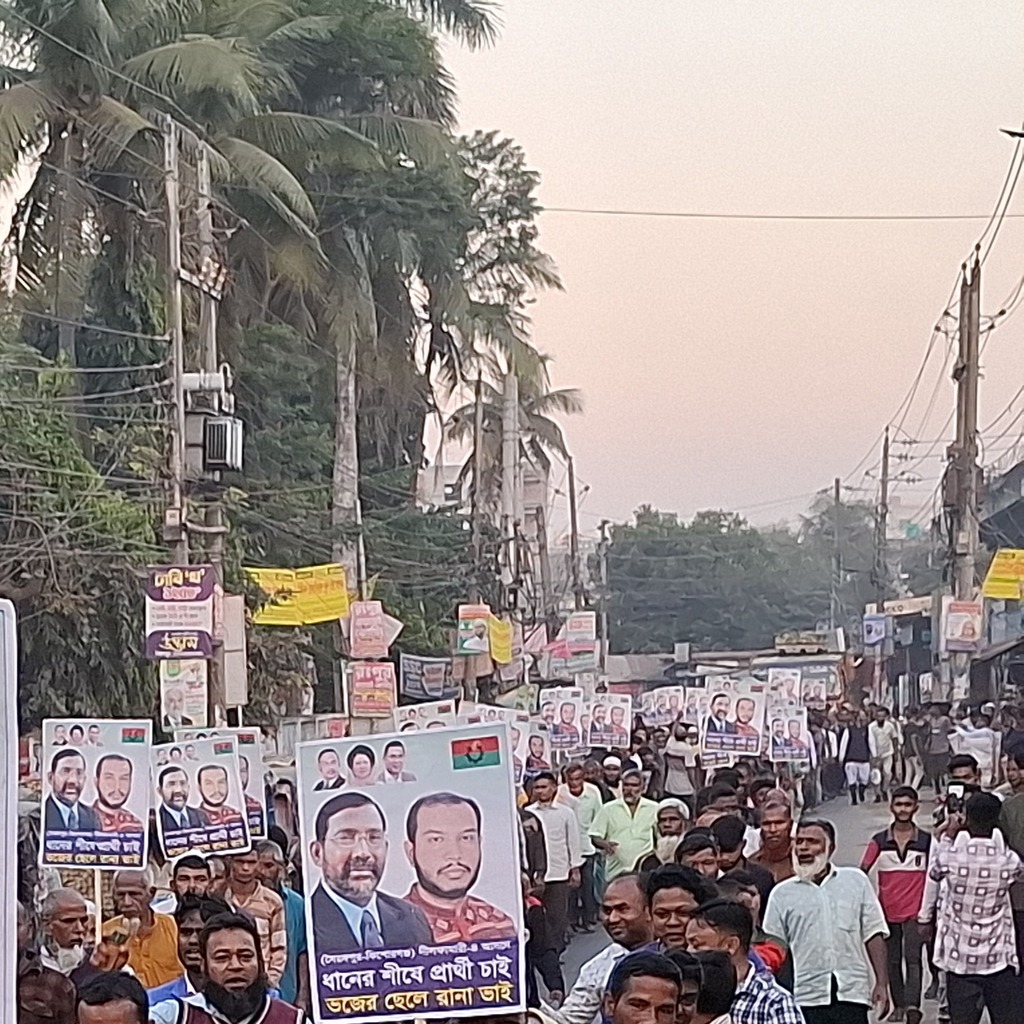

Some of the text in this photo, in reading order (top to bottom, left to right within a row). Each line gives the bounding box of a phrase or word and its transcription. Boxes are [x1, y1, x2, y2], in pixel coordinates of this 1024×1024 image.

[322, 954, 513, 991] ধানের শীষে প্রার্থী চাই
[325, 981, 514, 1014] ভজের ছেলে রানা ভাই
